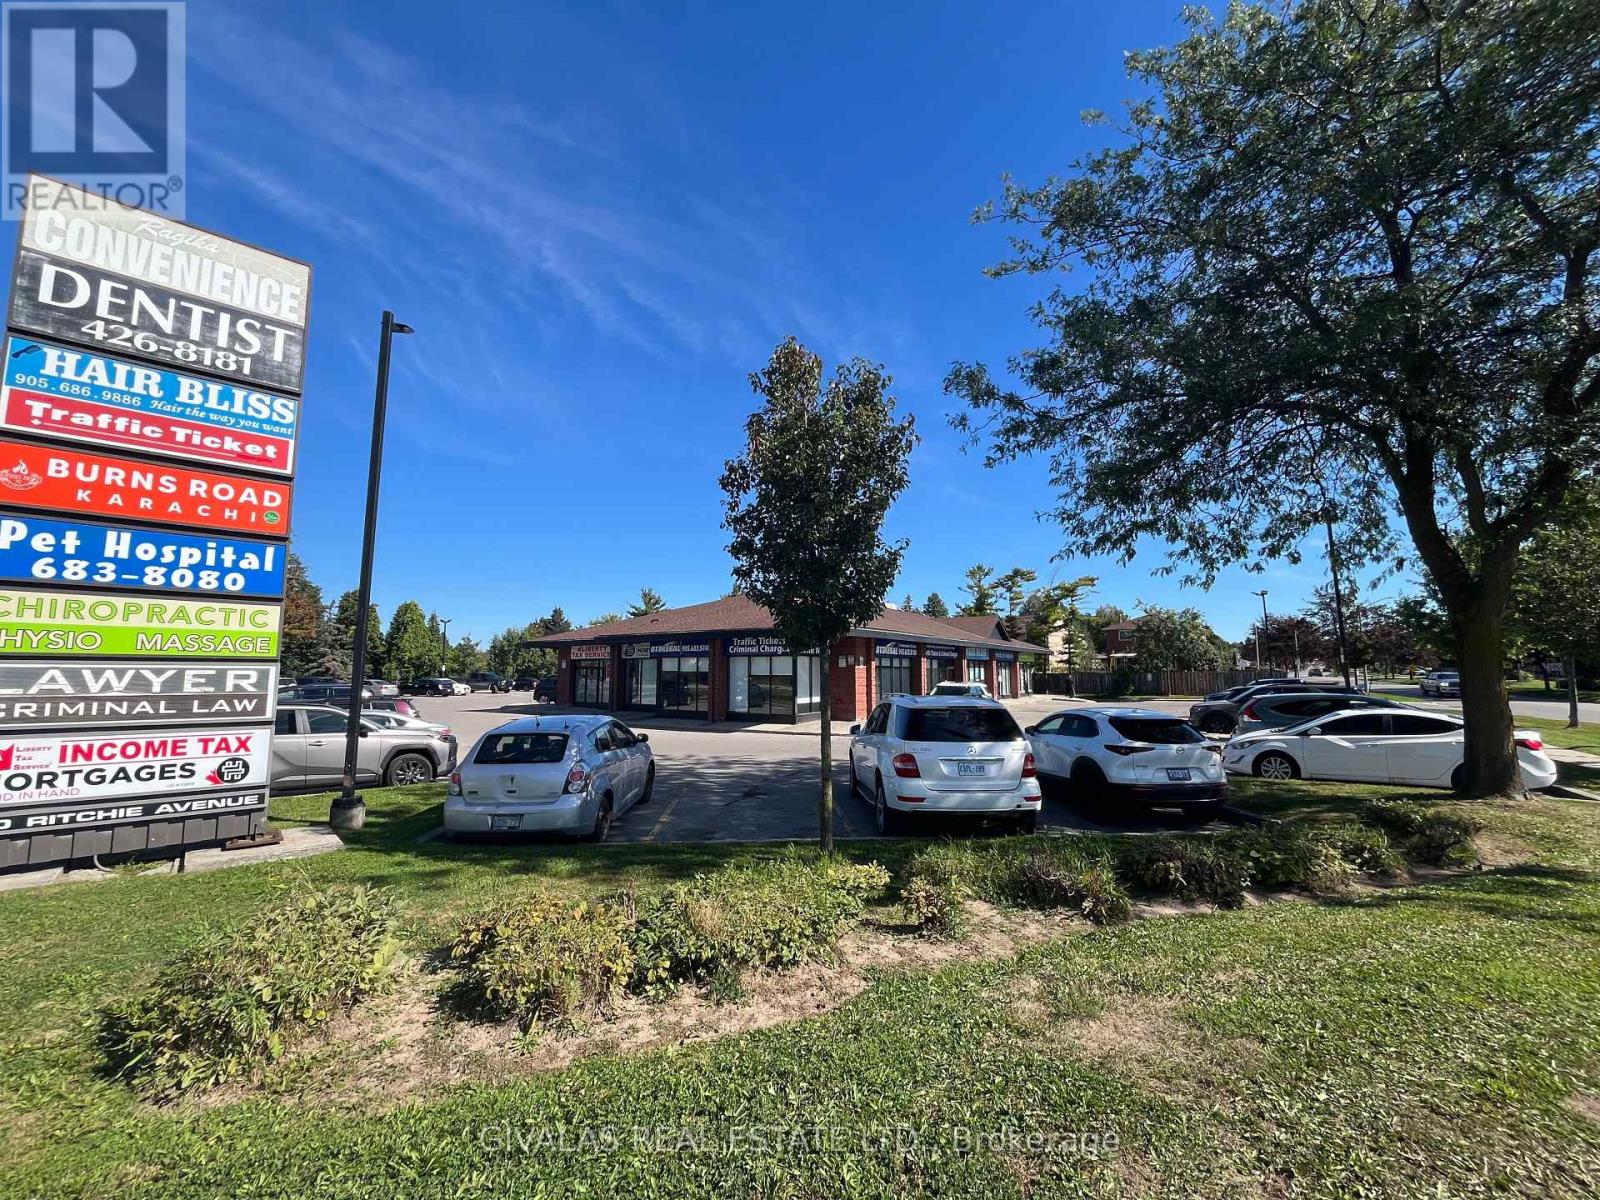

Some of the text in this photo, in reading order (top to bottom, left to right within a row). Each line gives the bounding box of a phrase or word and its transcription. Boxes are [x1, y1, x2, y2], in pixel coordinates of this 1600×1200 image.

[35, 209, 304, 326] CONVENIENCE
[38, 263, 297, 363] DENTIST
[81, 320, 252, 375] 426-8181
[40, 347, 295, 425] HAIR BLISS
[25, 399, 278, 459] Traffic Ticket
[149, 399, 293, 436] Hair the way you want
[47, 458, 177, 494] BURNS
[189, 478, 282, 508] ROAD
[76, 488, 256, 523] KARACHI
[0, 520, 275, 572] Pet Hospital
[31, 557, 245, 592] 683-8080
[0, 628, 271, 653] HYSIO MASSAGE
[728, 645, 759, 653] Criminal
[732, 638, 757, 646] Traffic
[192, 698, 258, 713] LAW
[58, 735, 253, 764] INCOME TAX
[0, 762, 196, 792] ORTGAGES
[38, 787, 80, 798] HAND
[27, 806, 143, 828] RITCHIE
[154, 794, 259, 815] AVENUE
